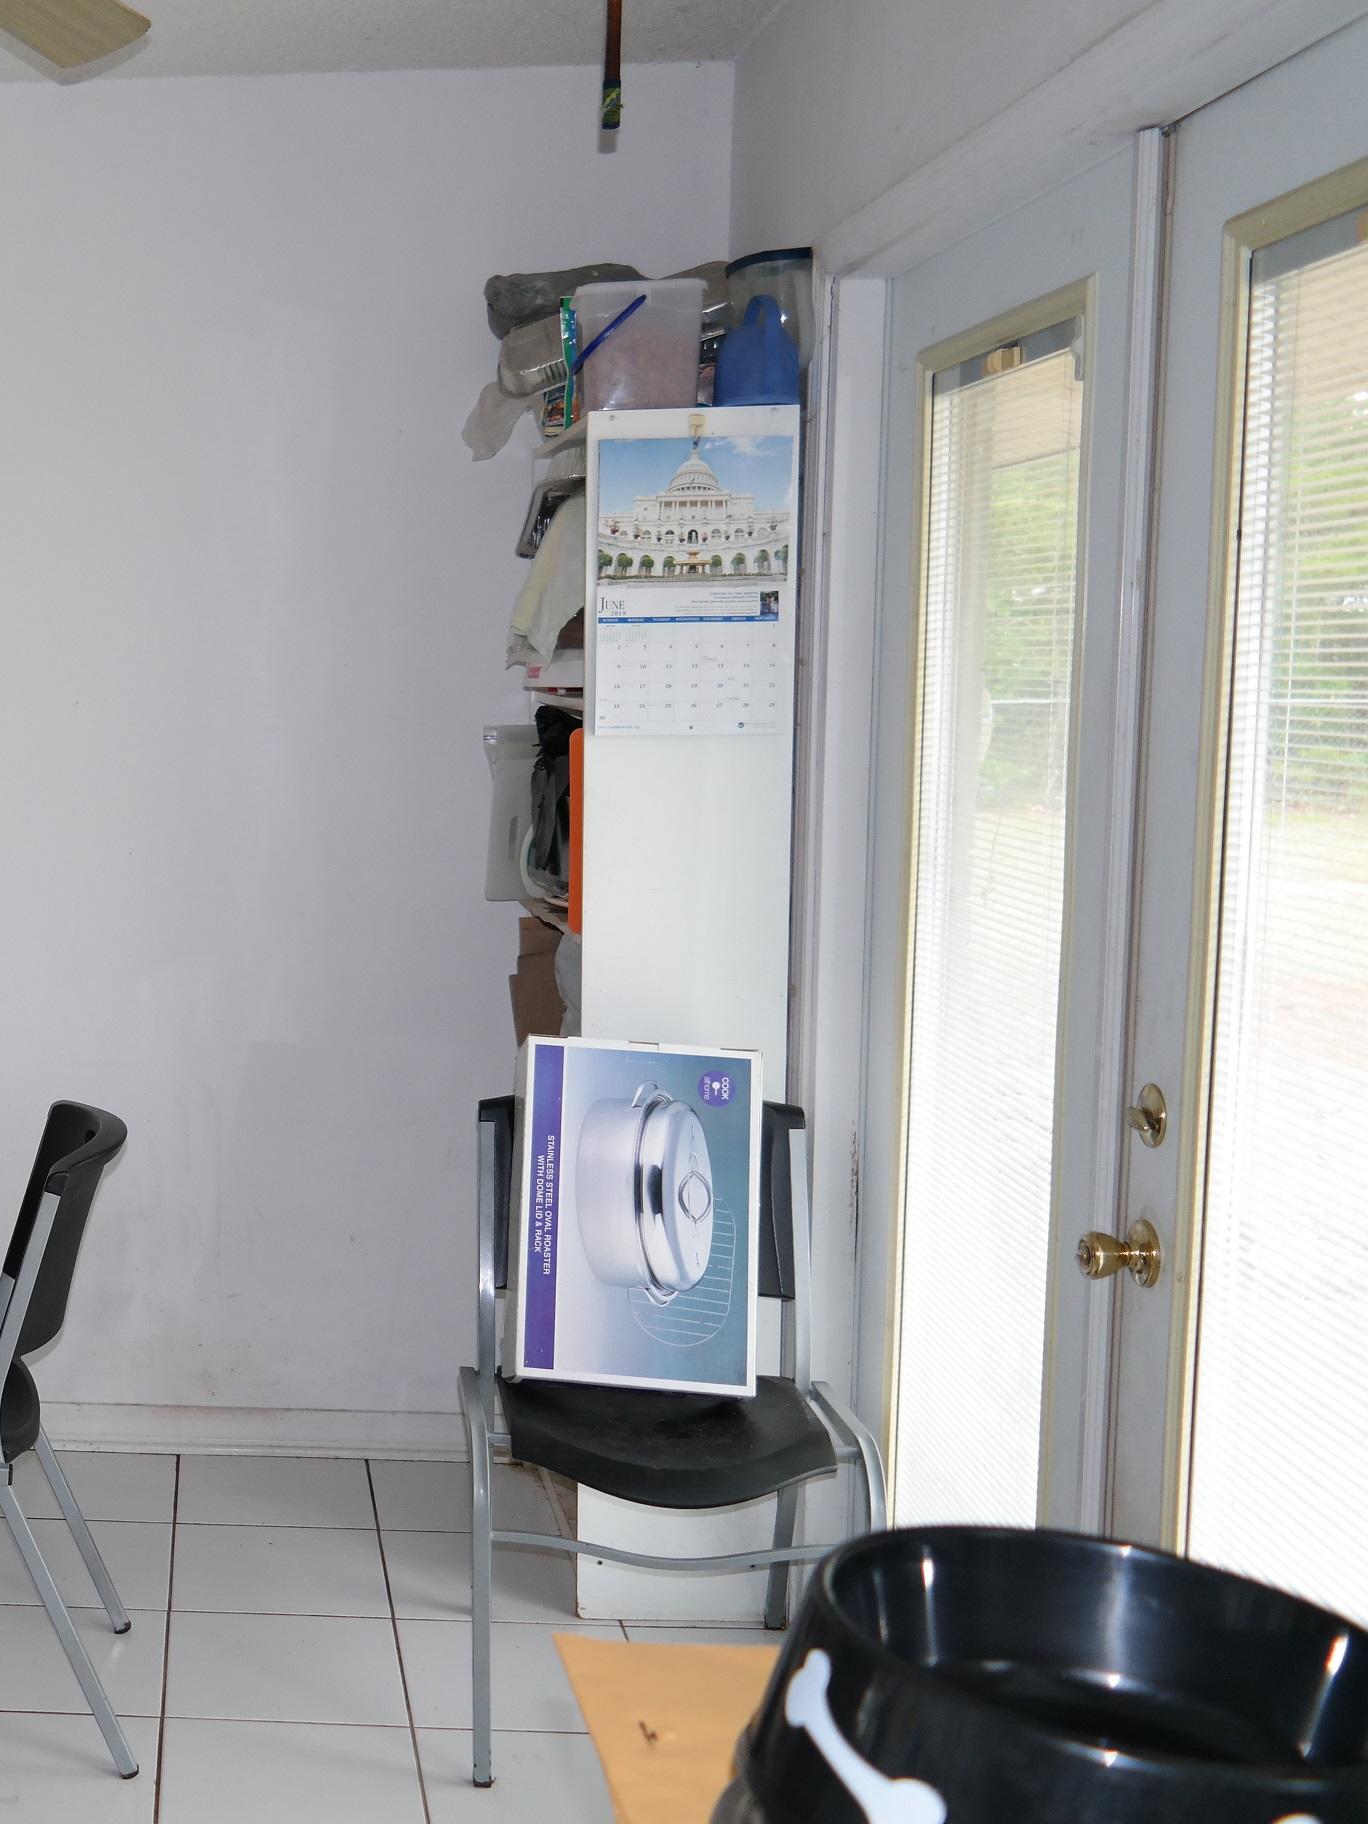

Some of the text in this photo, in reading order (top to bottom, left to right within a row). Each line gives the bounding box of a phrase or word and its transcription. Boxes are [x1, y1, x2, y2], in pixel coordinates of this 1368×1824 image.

[598, 597, 625, 613] JUNE
[721, 1077, 729, 1100] COOK
[536, 1154, 545, 1176] WITH
[535, 1178, 544, 1204] DOME
[535, 1205, 543, 1219] LID
[543, 1135, 555, 1275] STAINLESS STEEL OVAL ROASTER
[534, 1229, 543, 1253] RACK
